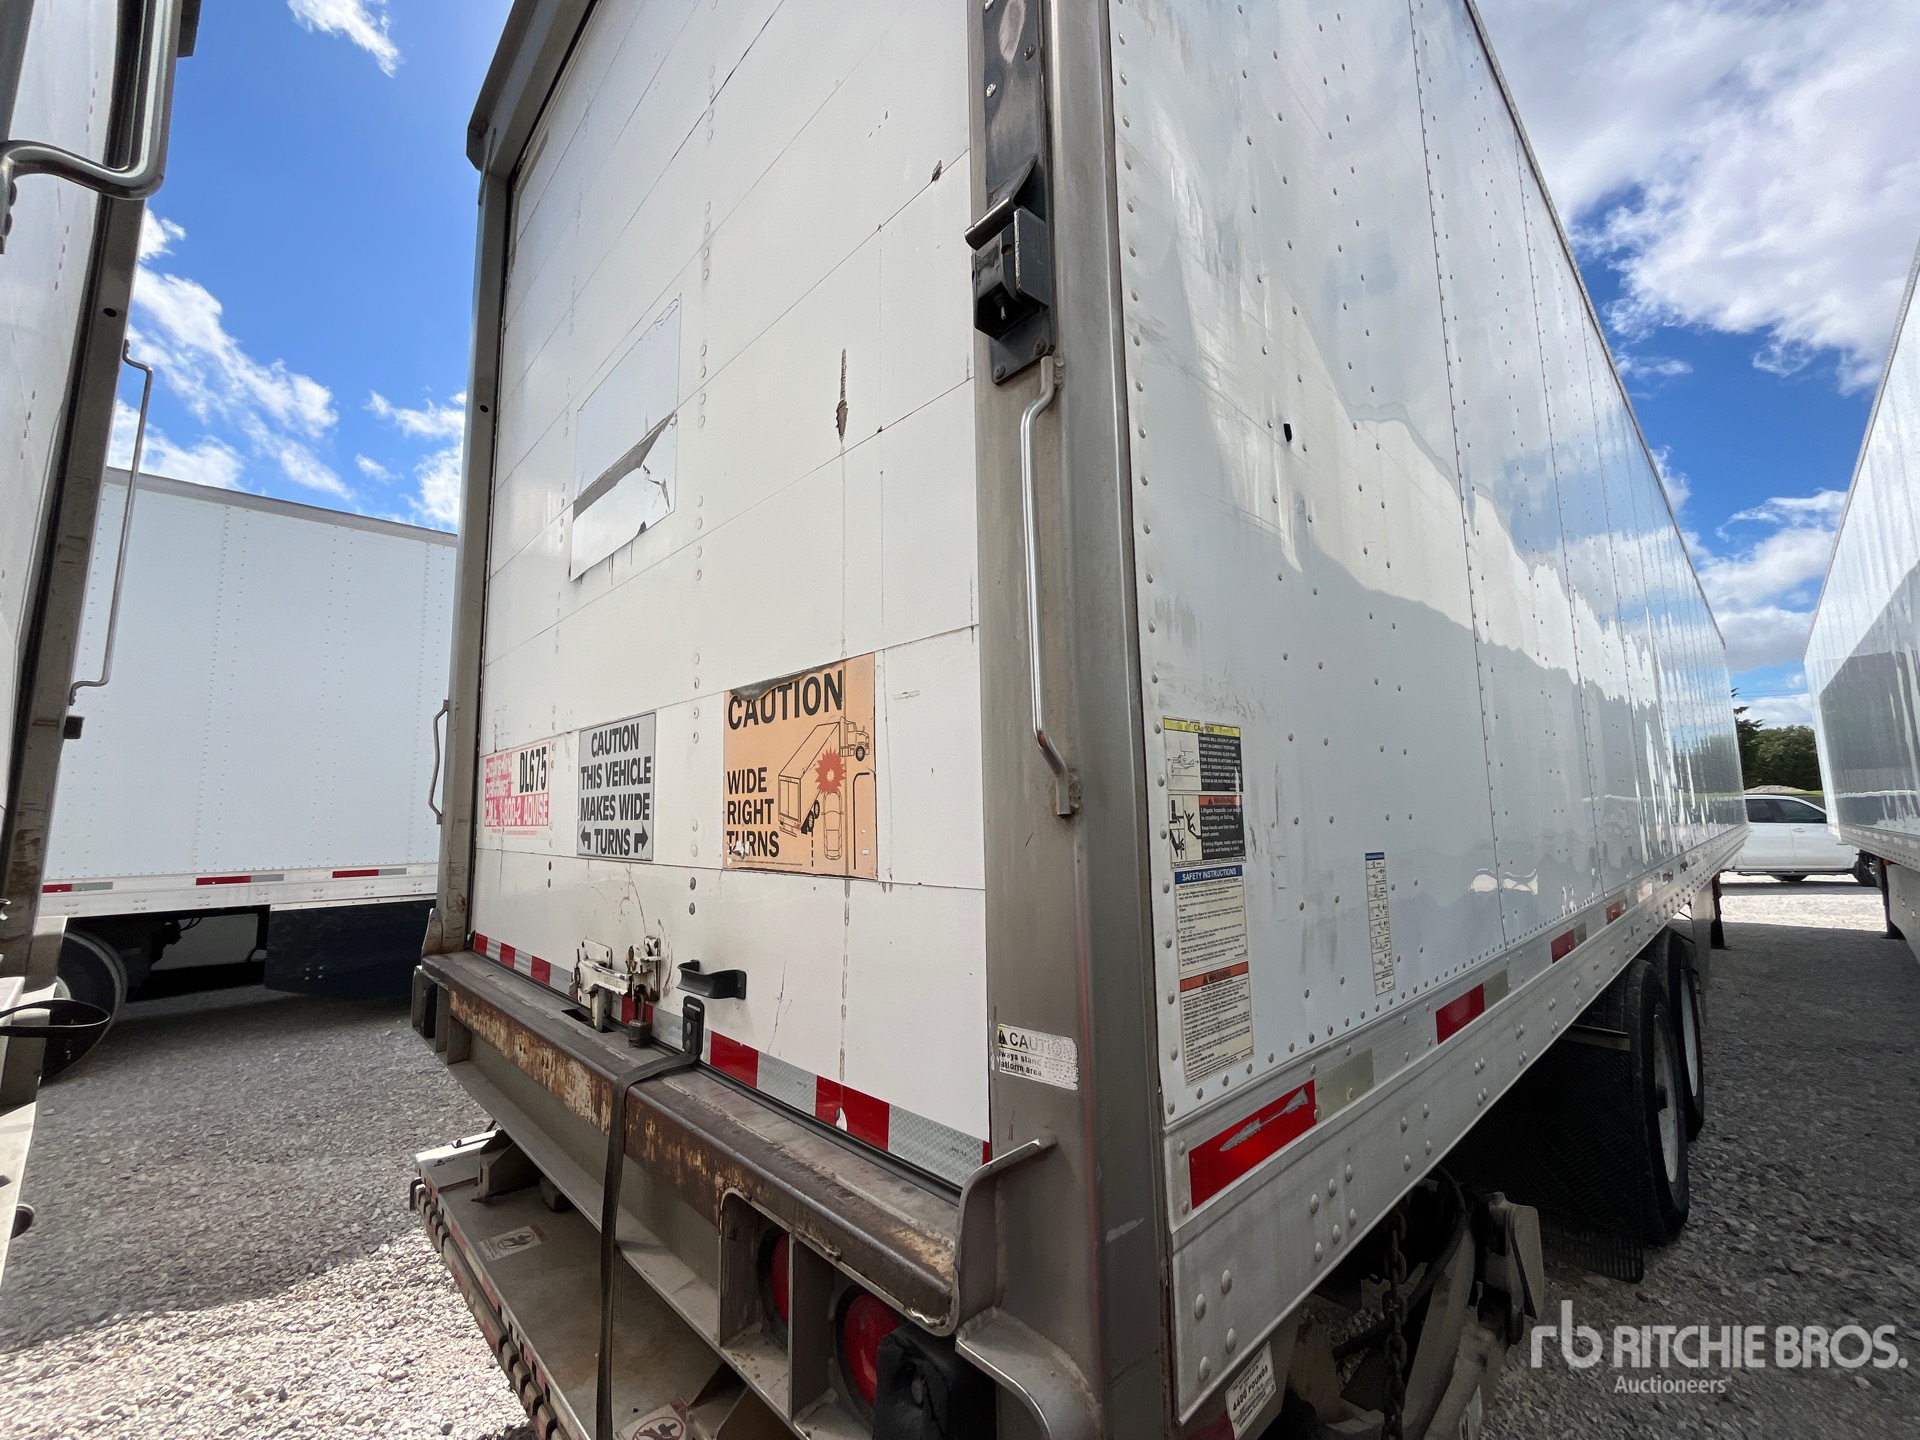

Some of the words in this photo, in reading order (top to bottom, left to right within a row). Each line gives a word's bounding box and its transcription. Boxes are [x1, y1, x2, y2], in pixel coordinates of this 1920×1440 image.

[728, 670, 842, 731] CAUTION
[591, 723, 639, 758] CAUTION
[1193, 723, 1215, 734] CAION
[519, 746, 547, 793] DL675
[581, 763, 602, 790] THIS
[605, 756, 651, 787] VEHICLE
[727, 767, 767, 795] WIDE
[523, 793, 548, 826] ADVISE
[580, 794, 616, 821] MAKES
[619, 793, 650, 820] WIDE
[727, 798, 774, 825] RIGHT
[594, 828, 631, 856] TURNS
[726, 830, 779, 858] TURNS
[1182, 871, 1202, 882] SAFETY
[1202, 867, 1237, 879] INSTRUCTIONS
